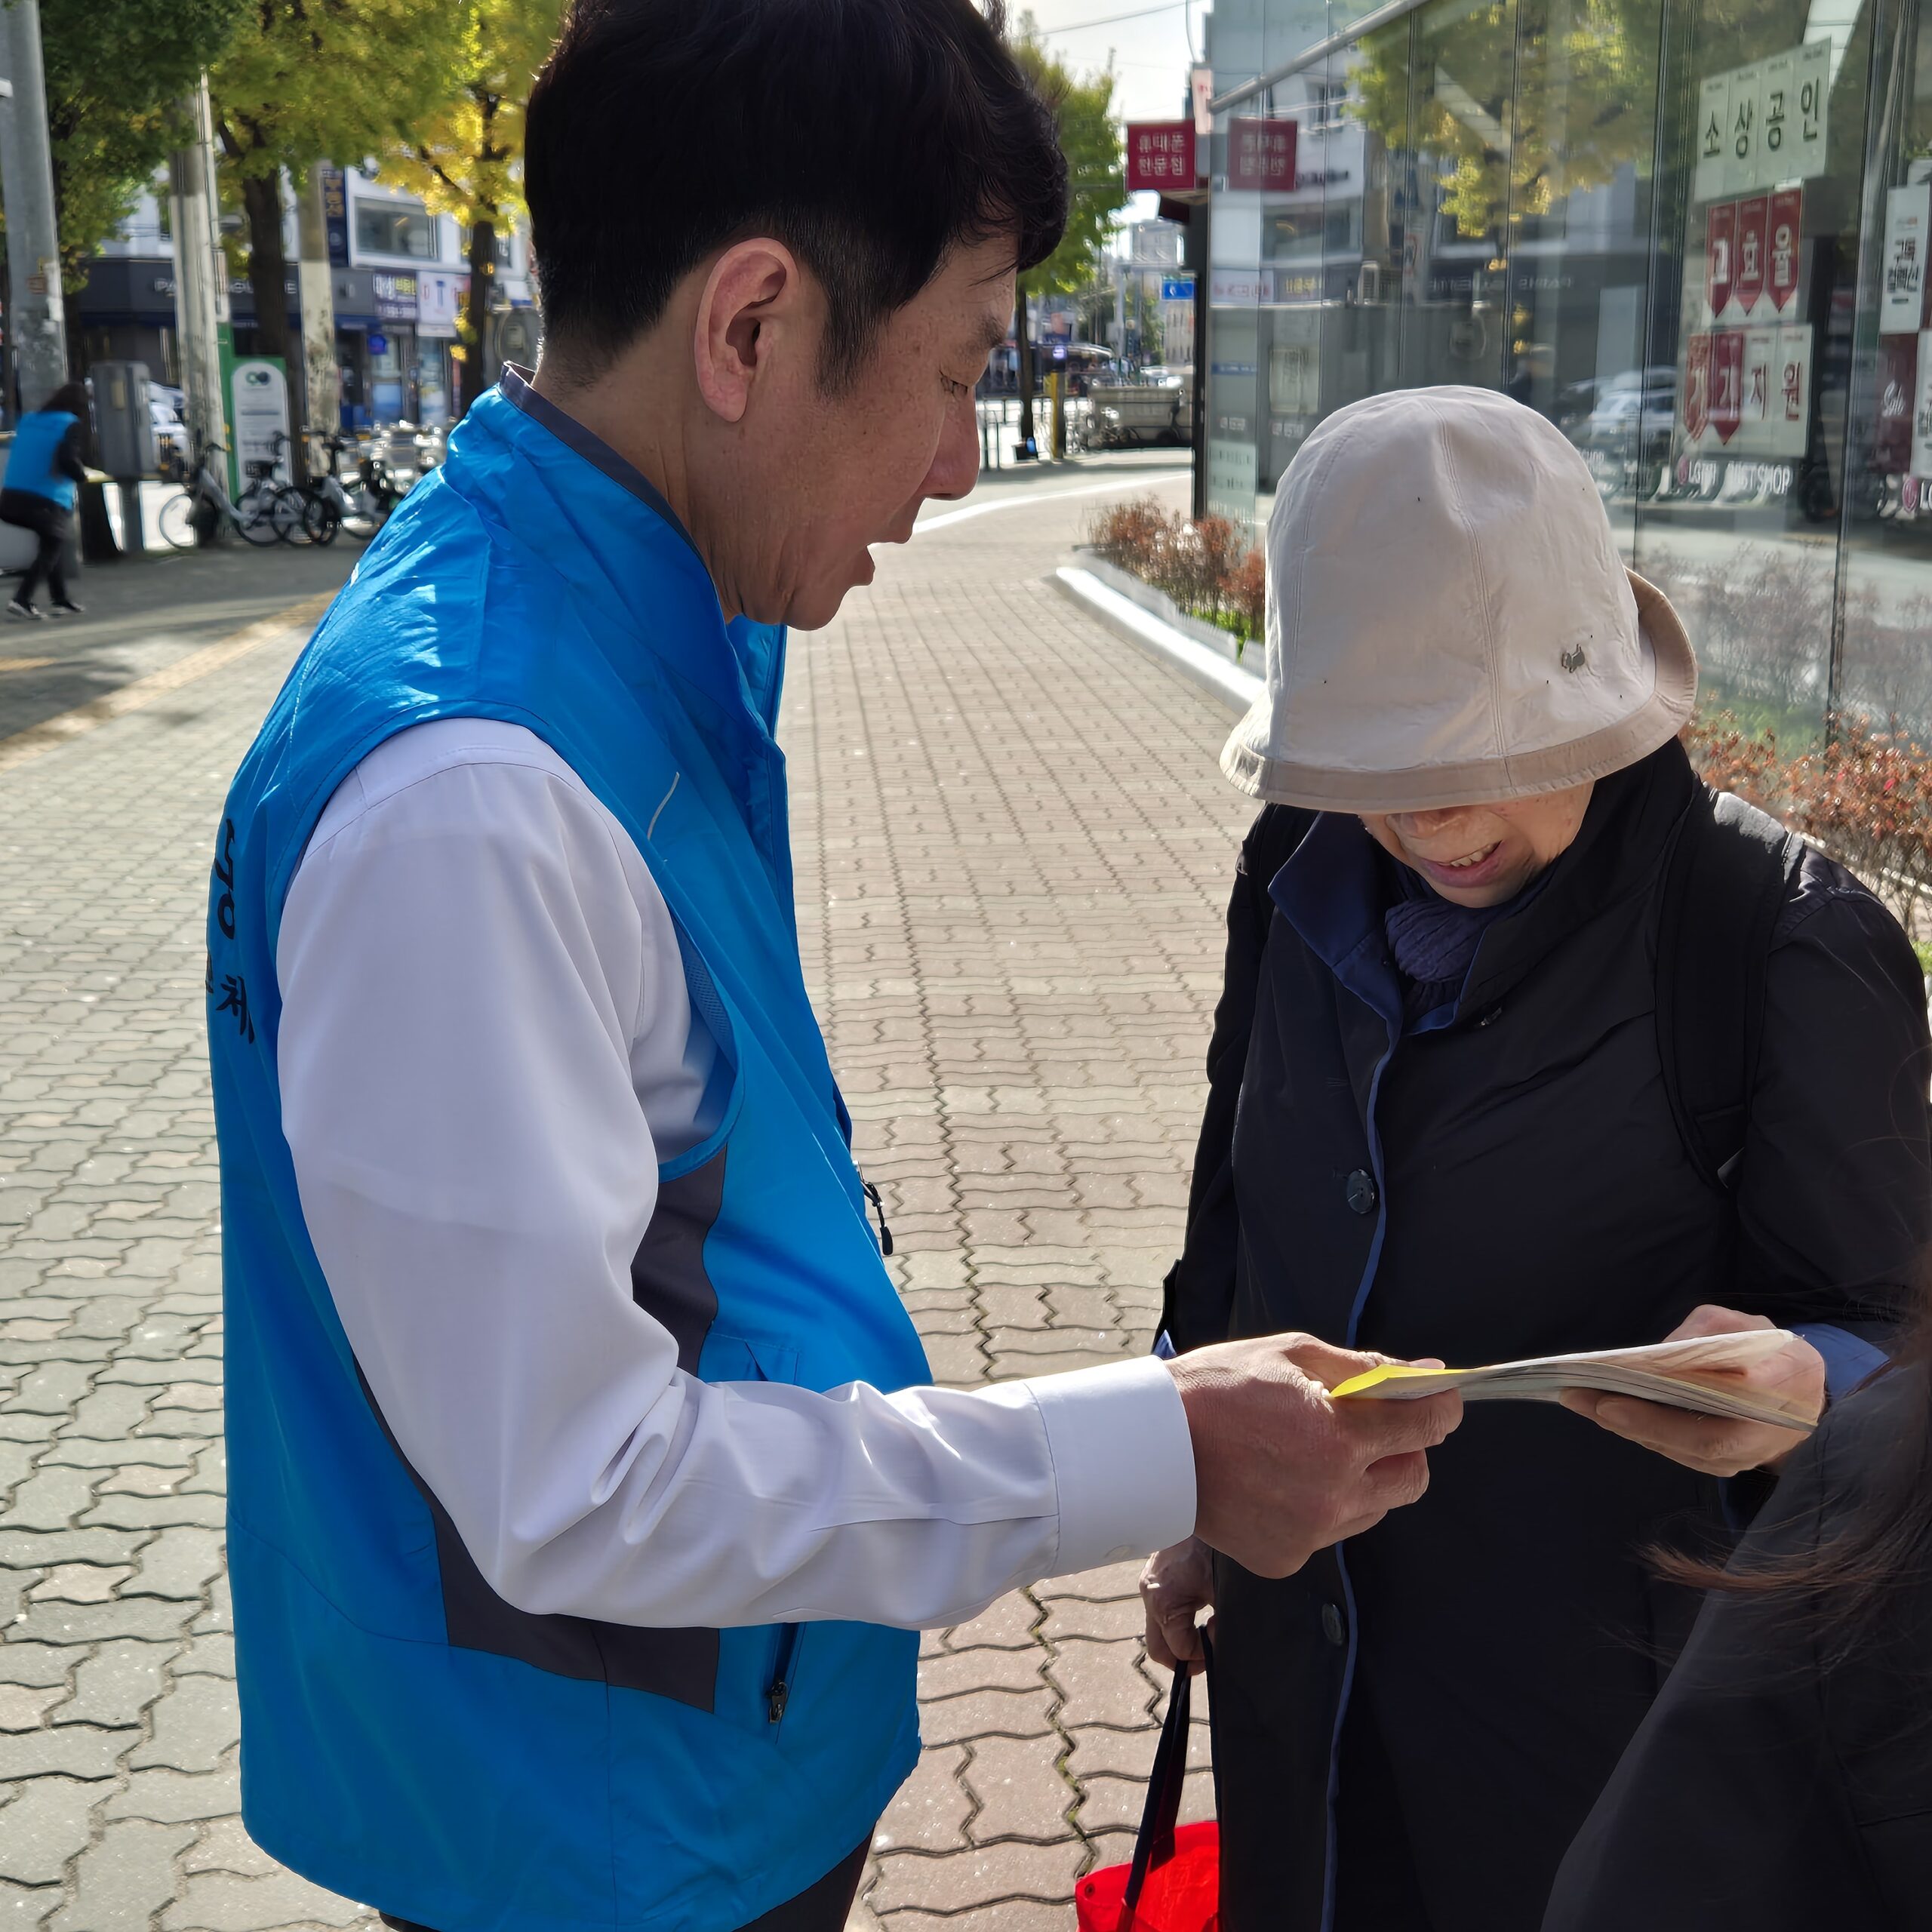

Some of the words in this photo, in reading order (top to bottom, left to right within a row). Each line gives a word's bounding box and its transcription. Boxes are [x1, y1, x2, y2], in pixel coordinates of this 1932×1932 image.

[1703, 76, 1820, 159] 소상공인
[1138, 131, 1185, 153] 휴대폰
[1138, 155, 1184, 177] 전문점
[1711, 223, 1792, 287] 고효율
